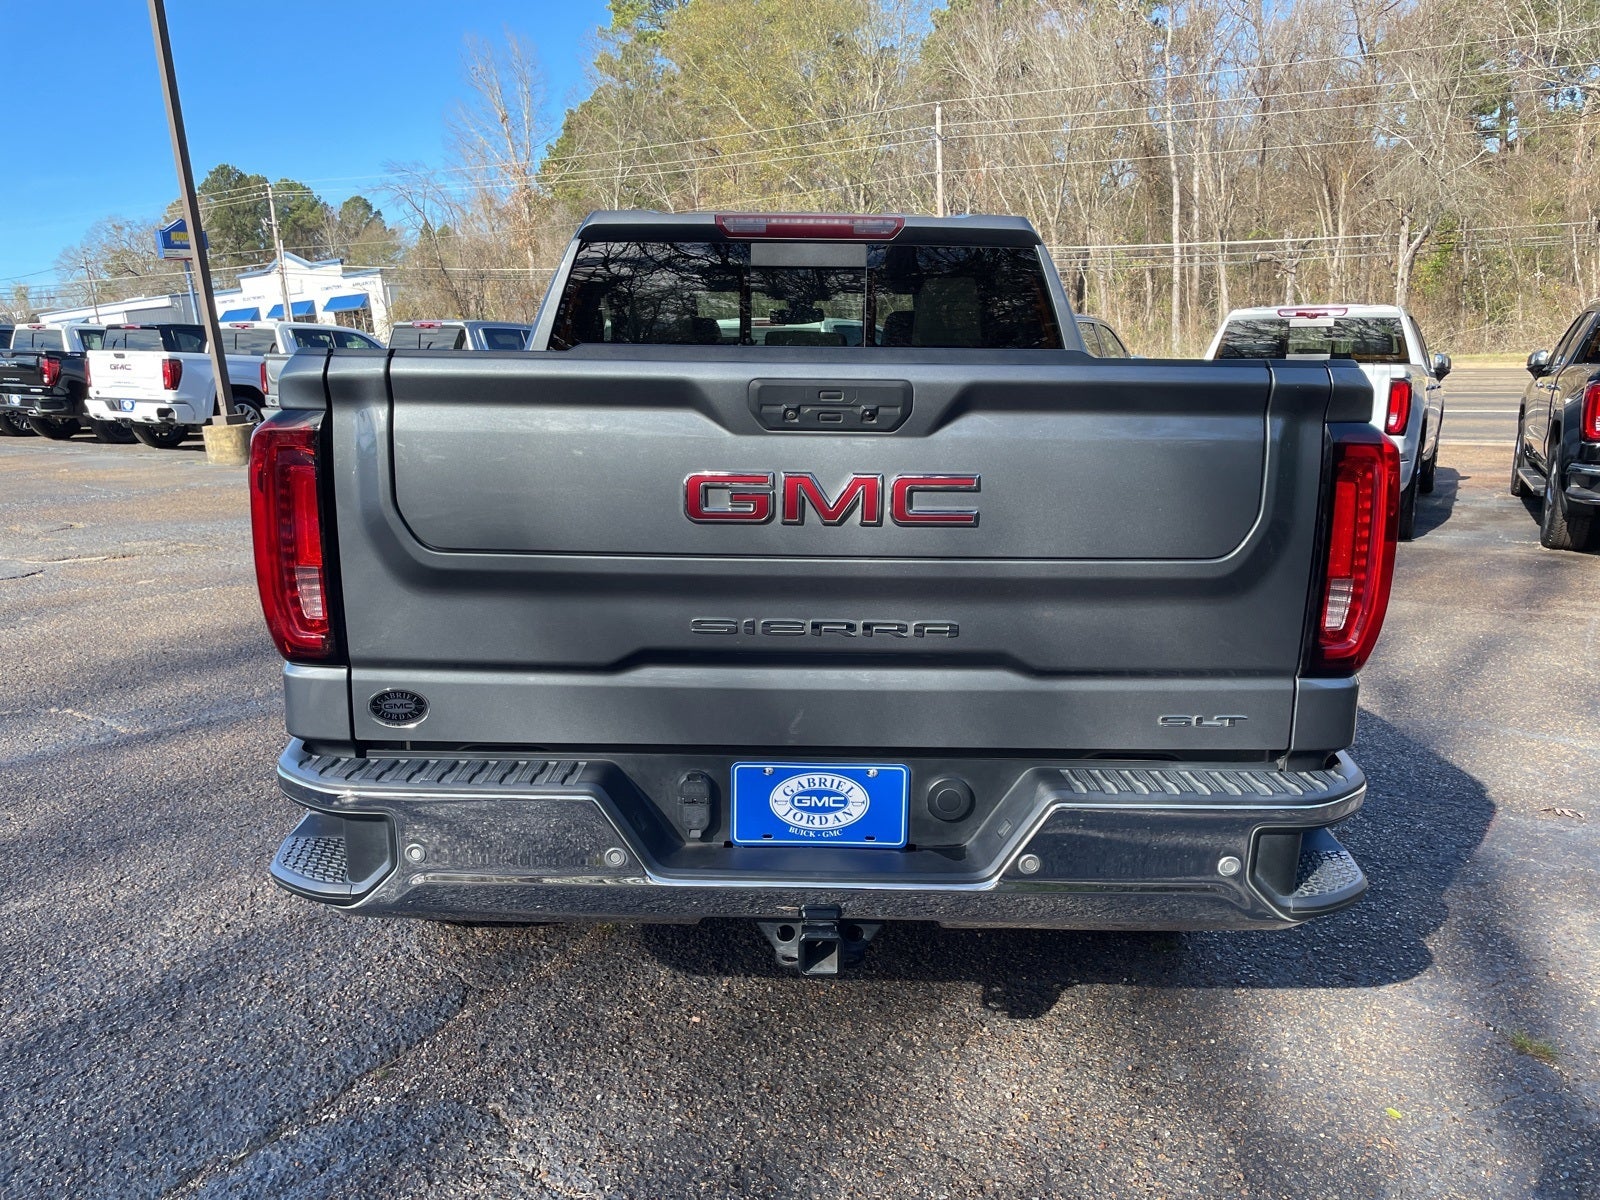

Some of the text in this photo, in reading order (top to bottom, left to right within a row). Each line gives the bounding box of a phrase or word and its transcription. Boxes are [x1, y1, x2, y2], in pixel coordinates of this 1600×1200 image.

[683, 471, 981, 527] GMC
[691, 617, 960, 638] SIERRA
[376, 692, 417, 704] GABRIEL
[378, 710, 419, 720] JORDAN
[1157, 714, 1248, 728] SLT
[782, 777, 855, 798] GABRIEL
[794, 795, 845, 808] GMC
[782, 807, 855, 826] JORDAN
[788, 826, 816, 838] BUICK
[822, 828, 844, 838] GMC
